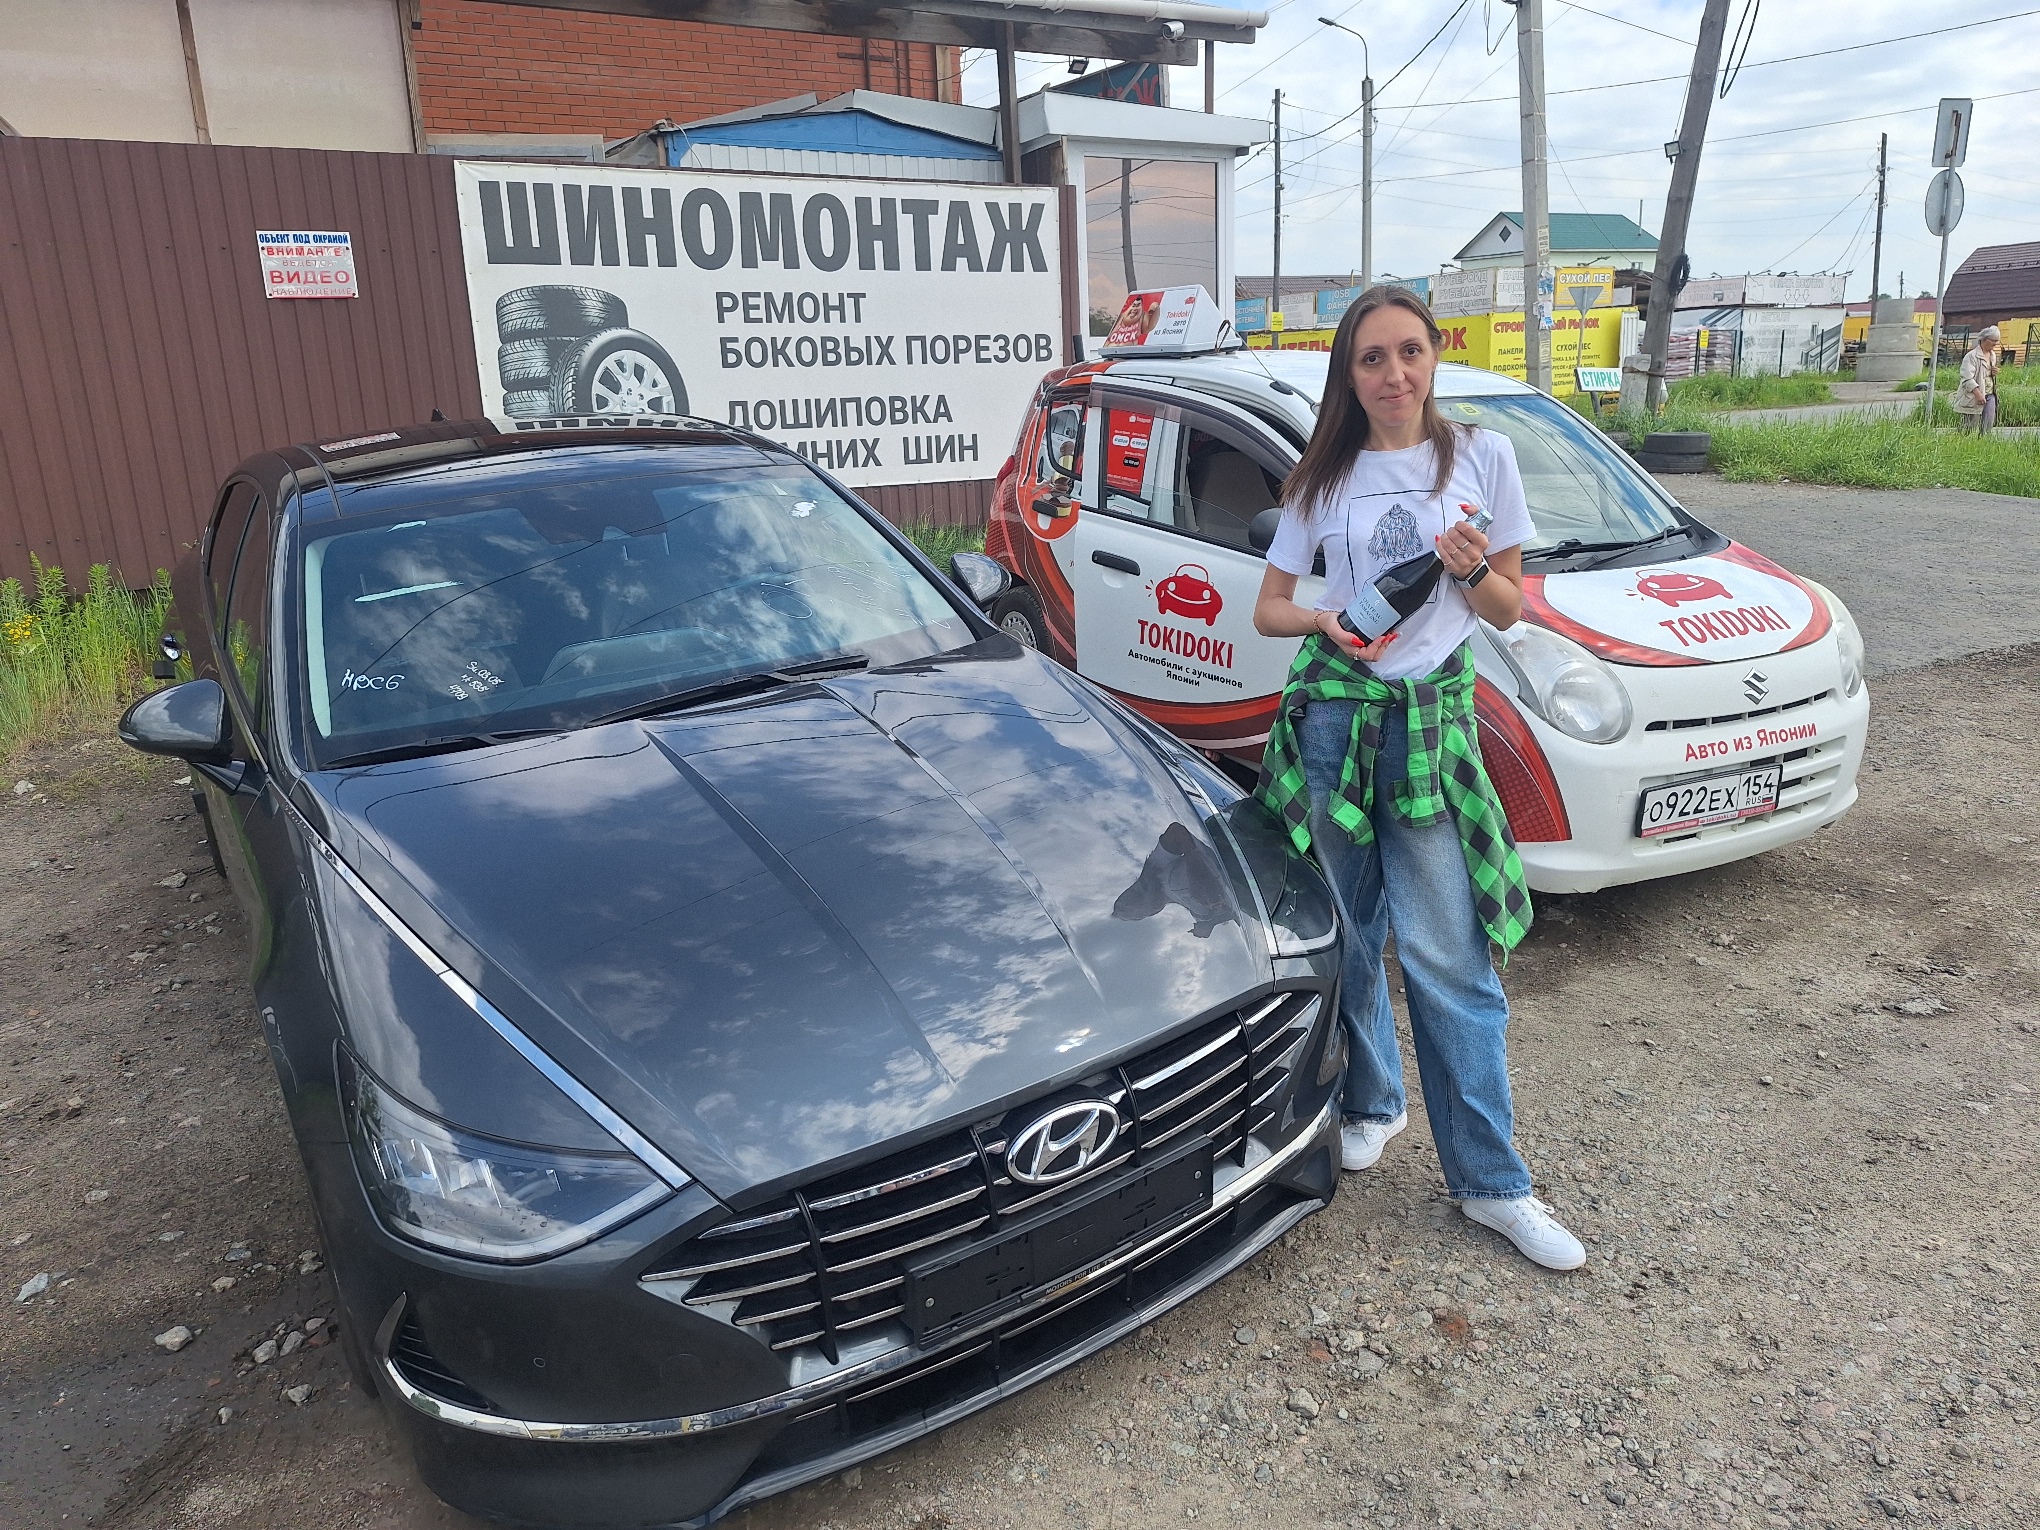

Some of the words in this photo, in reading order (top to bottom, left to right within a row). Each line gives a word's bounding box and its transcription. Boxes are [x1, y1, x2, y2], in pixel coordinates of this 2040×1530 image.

[259, 234, 290, 244] ОБЪЕКТ
[293, 234, 310, 245] ПОД
[313, 233, 349, 245] ОХРАНОЙ
[478, 180, 1049, 272] ШИНОМОНТАЖ
[269, 270, 350, 285] ВИДЕО
[1560, 271, 1590, 284] СУХОЙ
[1592, 273, 1612, 283] ЛЕС
[271, 288, 352, 296] НАБЛЮДЕНИЕ
[715, 292, 867, 324] РЕМОНТ
[1109, 330, 1138, 343] ОМСК
[1556, 342, 1578, 352] СУХОЙ
[720, 336, 897, 369] БОКОВЫХ
[906, 334, 1053, 364] ПОРЕЗОВ
[1498, 348, 1524, 356] ПАНЕЛИ
[1581, 370, 1621, 388] СТИРКА
[728, 395, 954, 431] ДОШИПОВКА
[903, 434, 979, 465] ШИН
[1658, 605, 1792, 647] TOKIDOKI
[1138, 619, 1234, 669] TOKIDOKI
[1127, 648, 1184, 672] Автомобили
[1191, 668, 1244, 689] аукционов
[1166, 670, 1201, 688] Японии
[1684, 740, 1729, 763] Авто
[1733, 734, 1754, 753] из
[1756, 722, 1818, 748] Японии
[1742, 772, 1774, 798] 154
[1745, 795, 1763, 807] RUS
[1045, 1278, 1073, 1295] MOTORS
[1074, 1271, 1087, 1282] FOR
[1088, 1264, 1101, 1274] LIFE
